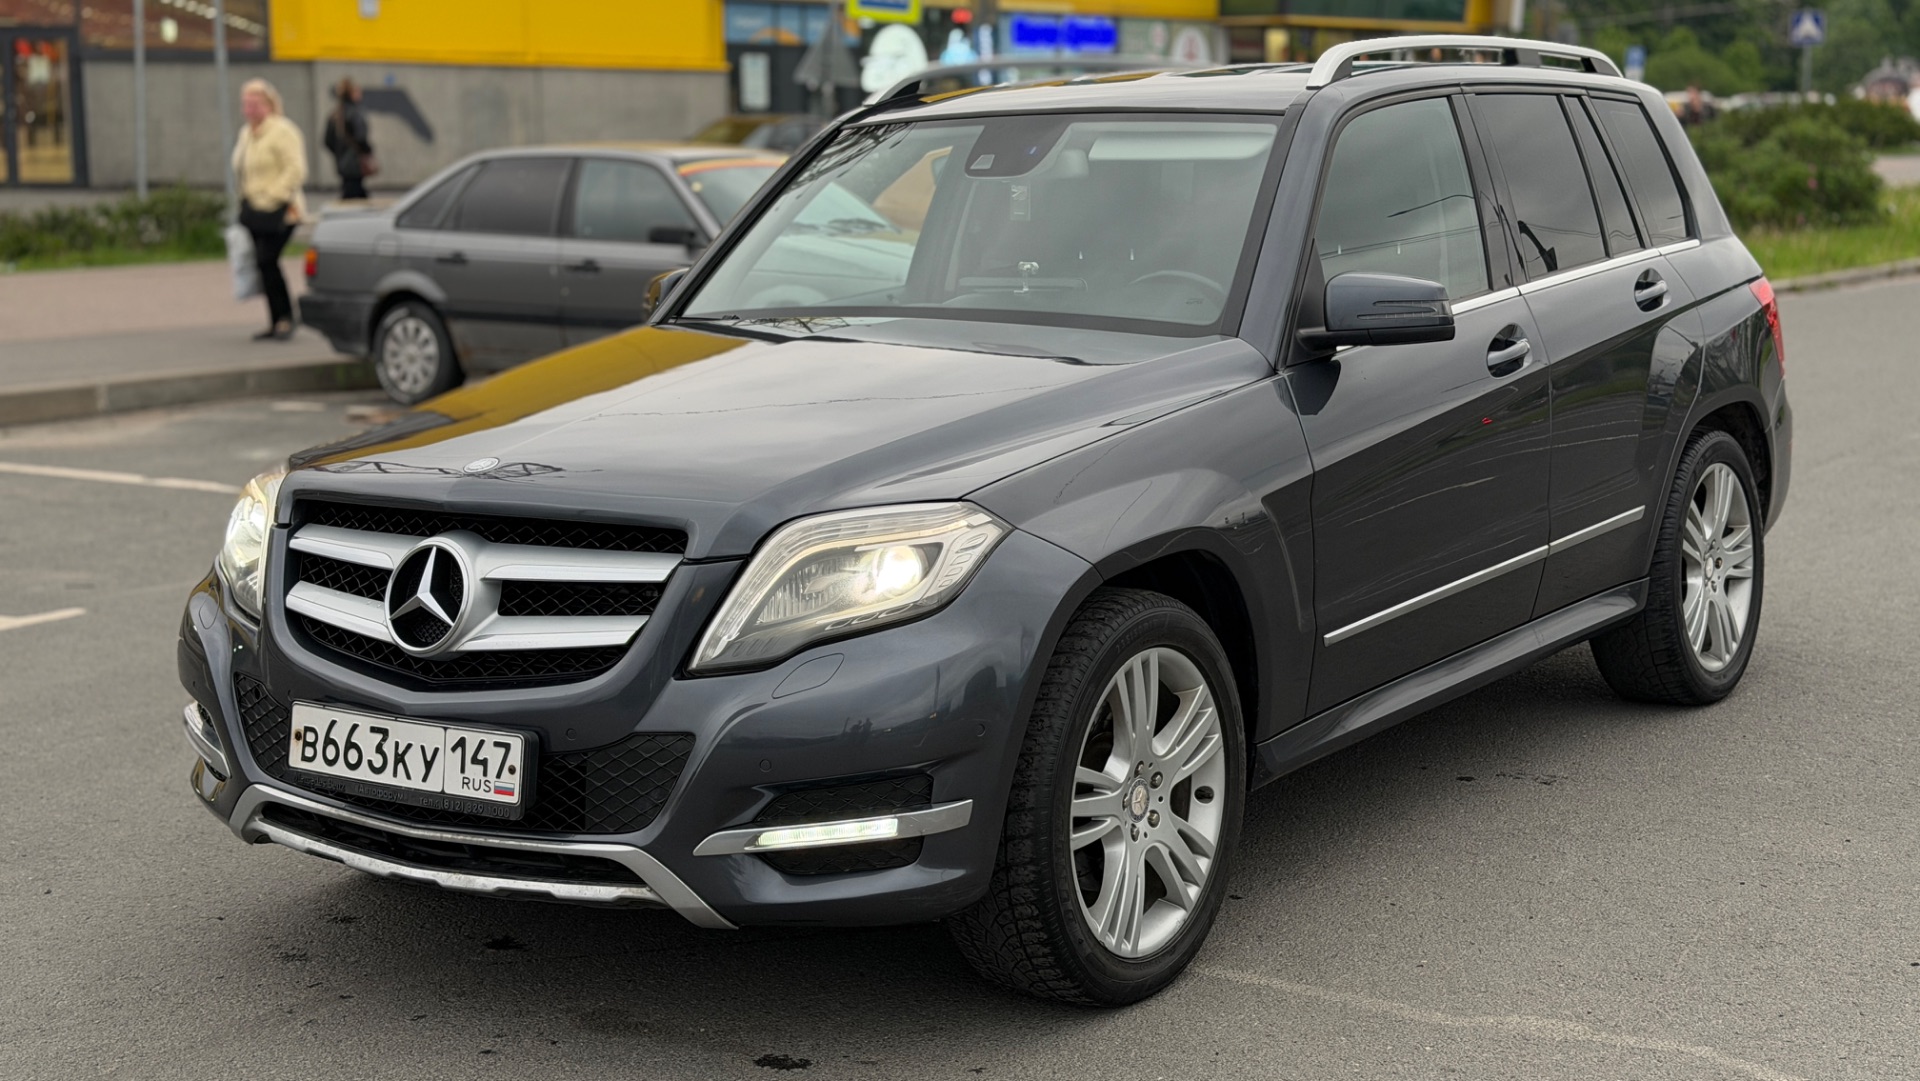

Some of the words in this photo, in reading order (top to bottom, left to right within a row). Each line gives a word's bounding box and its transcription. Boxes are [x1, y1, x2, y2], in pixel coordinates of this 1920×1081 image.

[301, 719, 440, 783] В663КУ
[451, 736, 511, 779] 147
[461, 776, 492, 793] RUS
